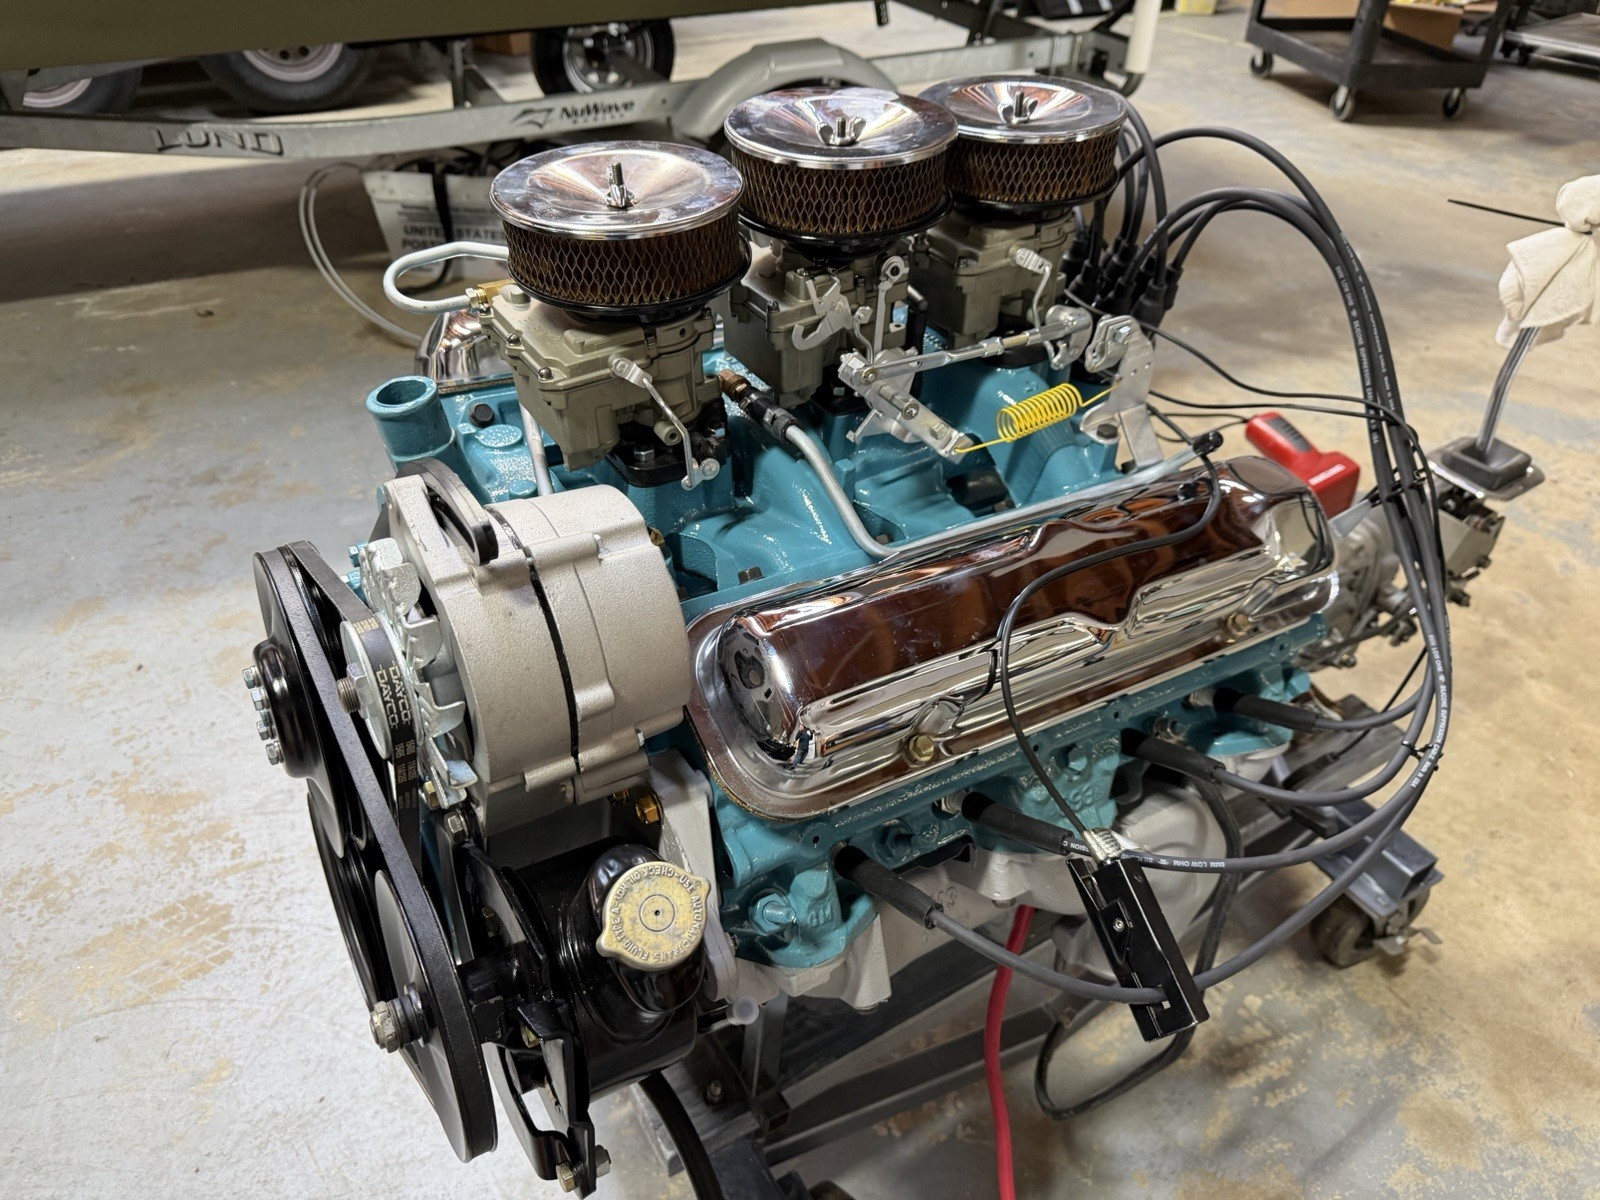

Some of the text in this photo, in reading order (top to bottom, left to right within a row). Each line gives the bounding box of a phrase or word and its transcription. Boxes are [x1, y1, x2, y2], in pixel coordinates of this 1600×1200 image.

[561, 101, 635, 119] NuWave
[156, 129, 284, 156] LUND
[403, 224, 441, 236] UNITE
[375, 664, 399, 730] DAYCO
[388, 660, 413, 726] DAYCO
[1439, 684, 1448, 709] SILICONE
[1436, 709, 1448, 744] SUPPRESSION
[1429, 743, 1441, 760] CABLE
[642, 865, 676, 878] CHECK
[1173, 859, 1190, 867] OHM
[1191, 860, 1207, 868] LOW
[626, 872, 642, 885] OIL
[678, 874, 696, 894] USE
[611, 916, 625, 941] TYPE
[682, 895, 704, 948] AUTOMATIC
[622, 940, 650, 961] FLUID
[653, 945, 687, 963] TRANS
